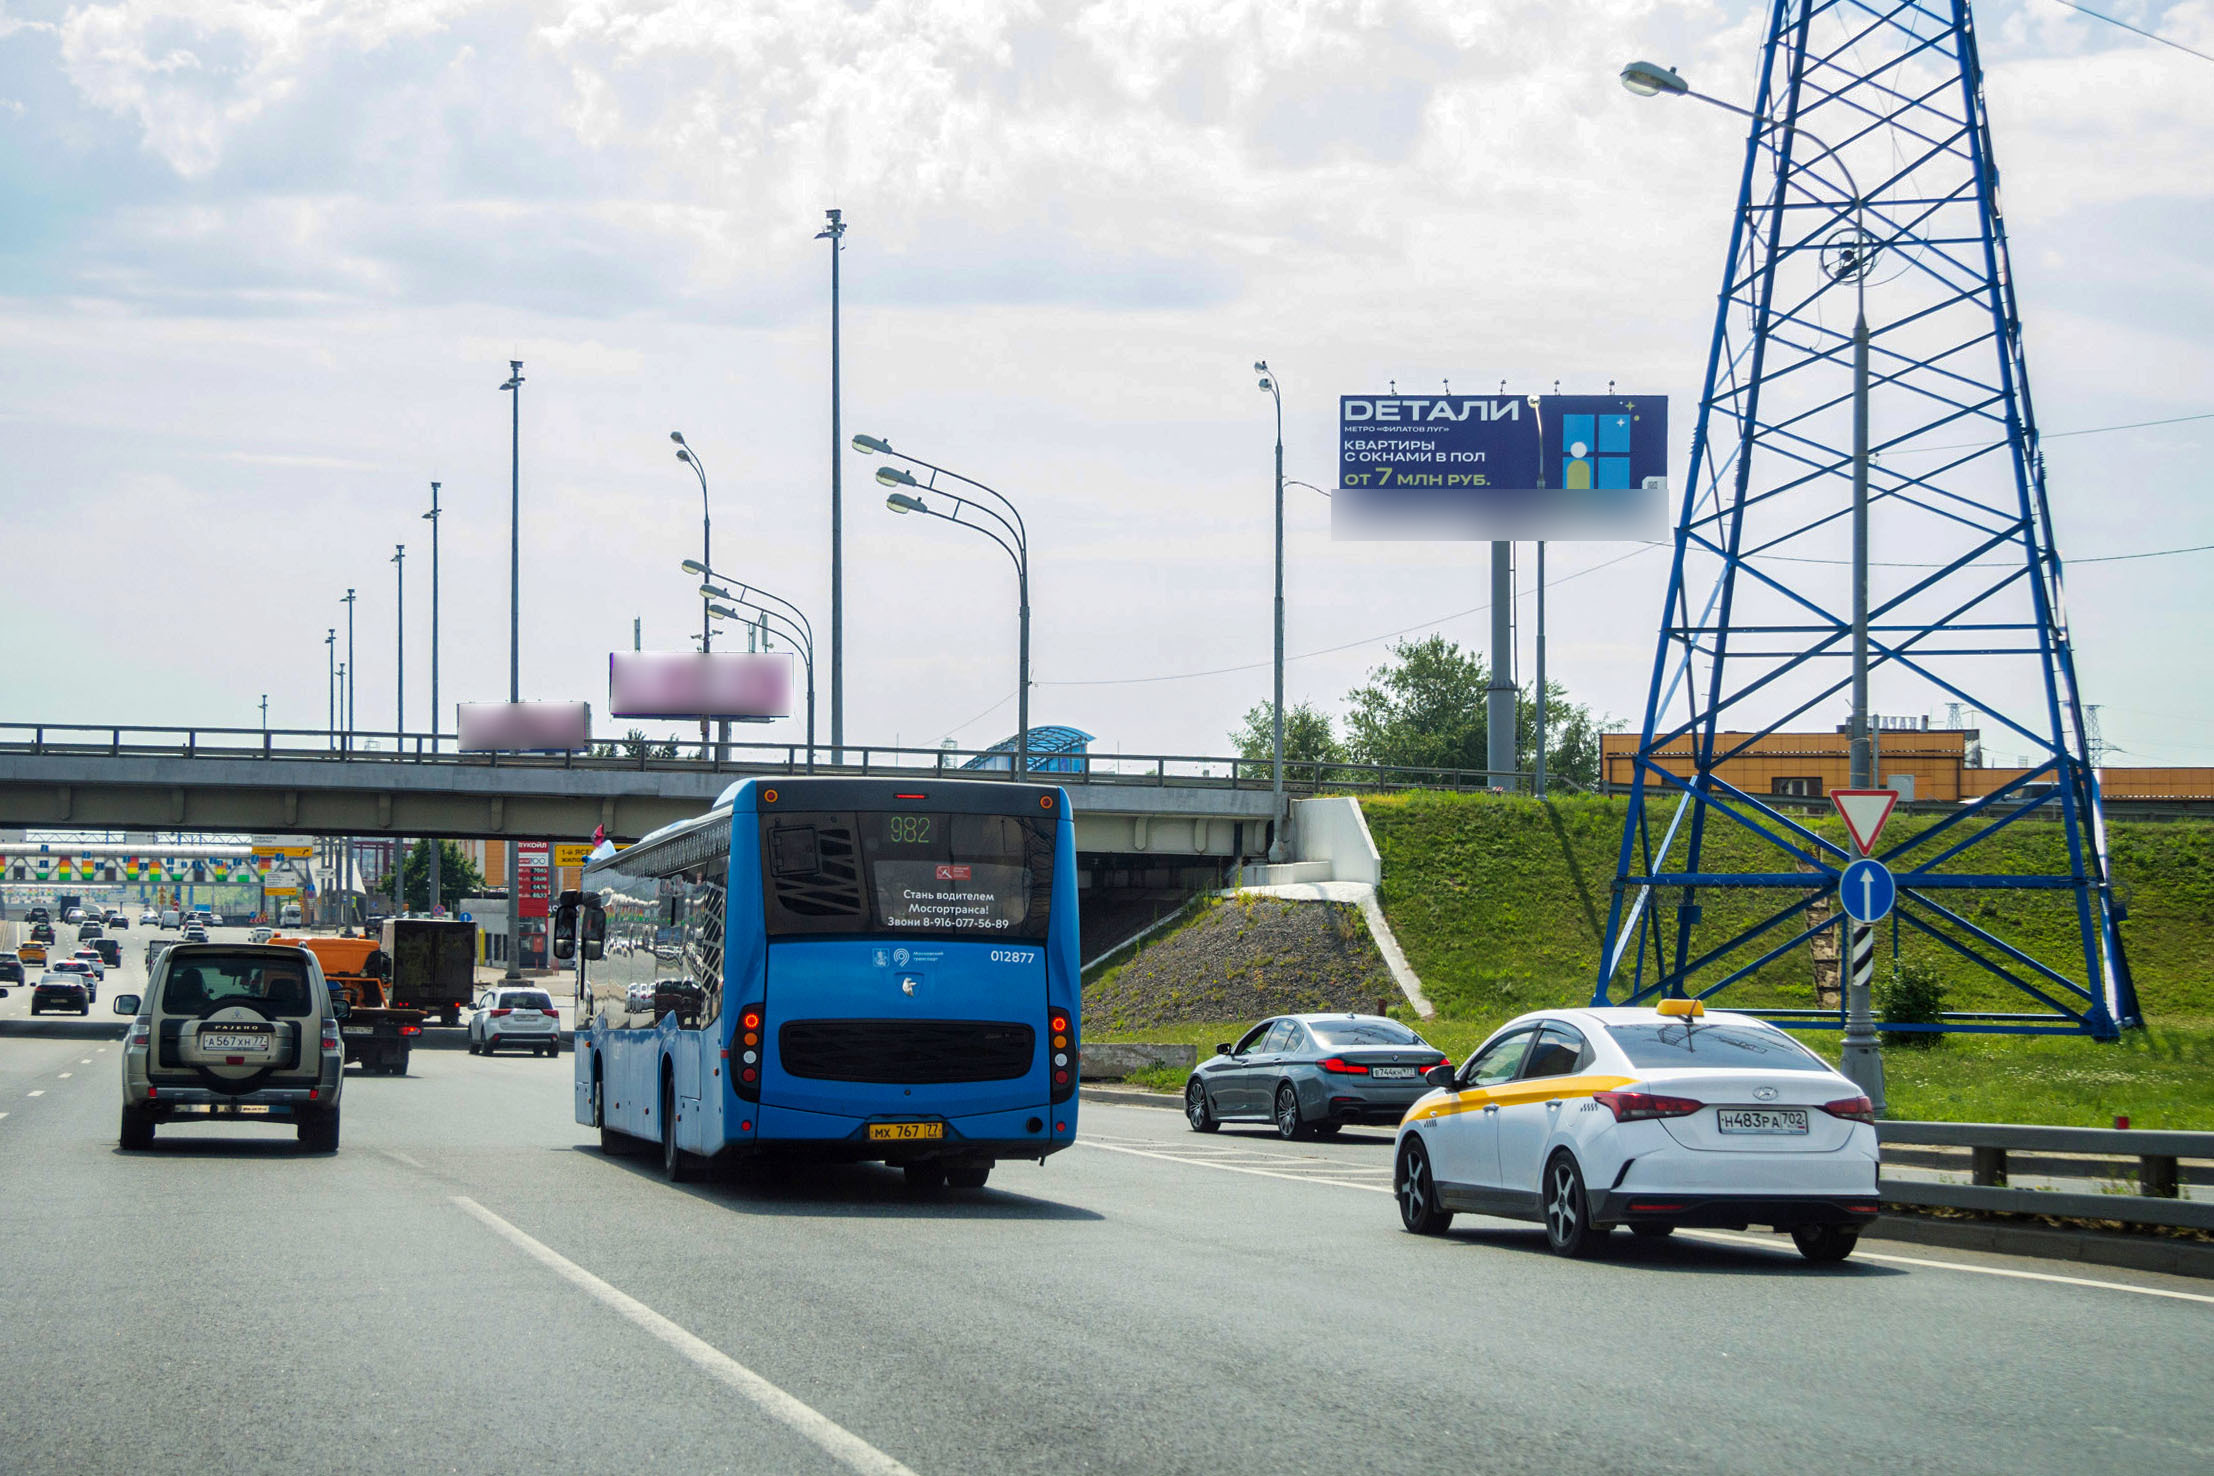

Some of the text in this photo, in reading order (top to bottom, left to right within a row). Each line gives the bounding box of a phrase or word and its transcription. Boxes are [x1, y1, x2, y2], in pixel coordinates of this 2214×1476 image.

[1344, 440, 1435, 450] КВАРТИРЫ
[1344, 452, 1485, 462] С ОКНАМИ В ПОЛ
[1344, 467, 1491, 485] ОТ 7 МЛН РУБ.
[890, 816, 930, 843] 982
[903, 889, 994, 902] Стань водителем
[908, 903, 989, 915] Мосгортранса!
[888, 917, 1009, 929] Звони 8-916-077-56-89
[991, 951, 1035, 964] 012877
[896, 1125, 919, 1137] 767
